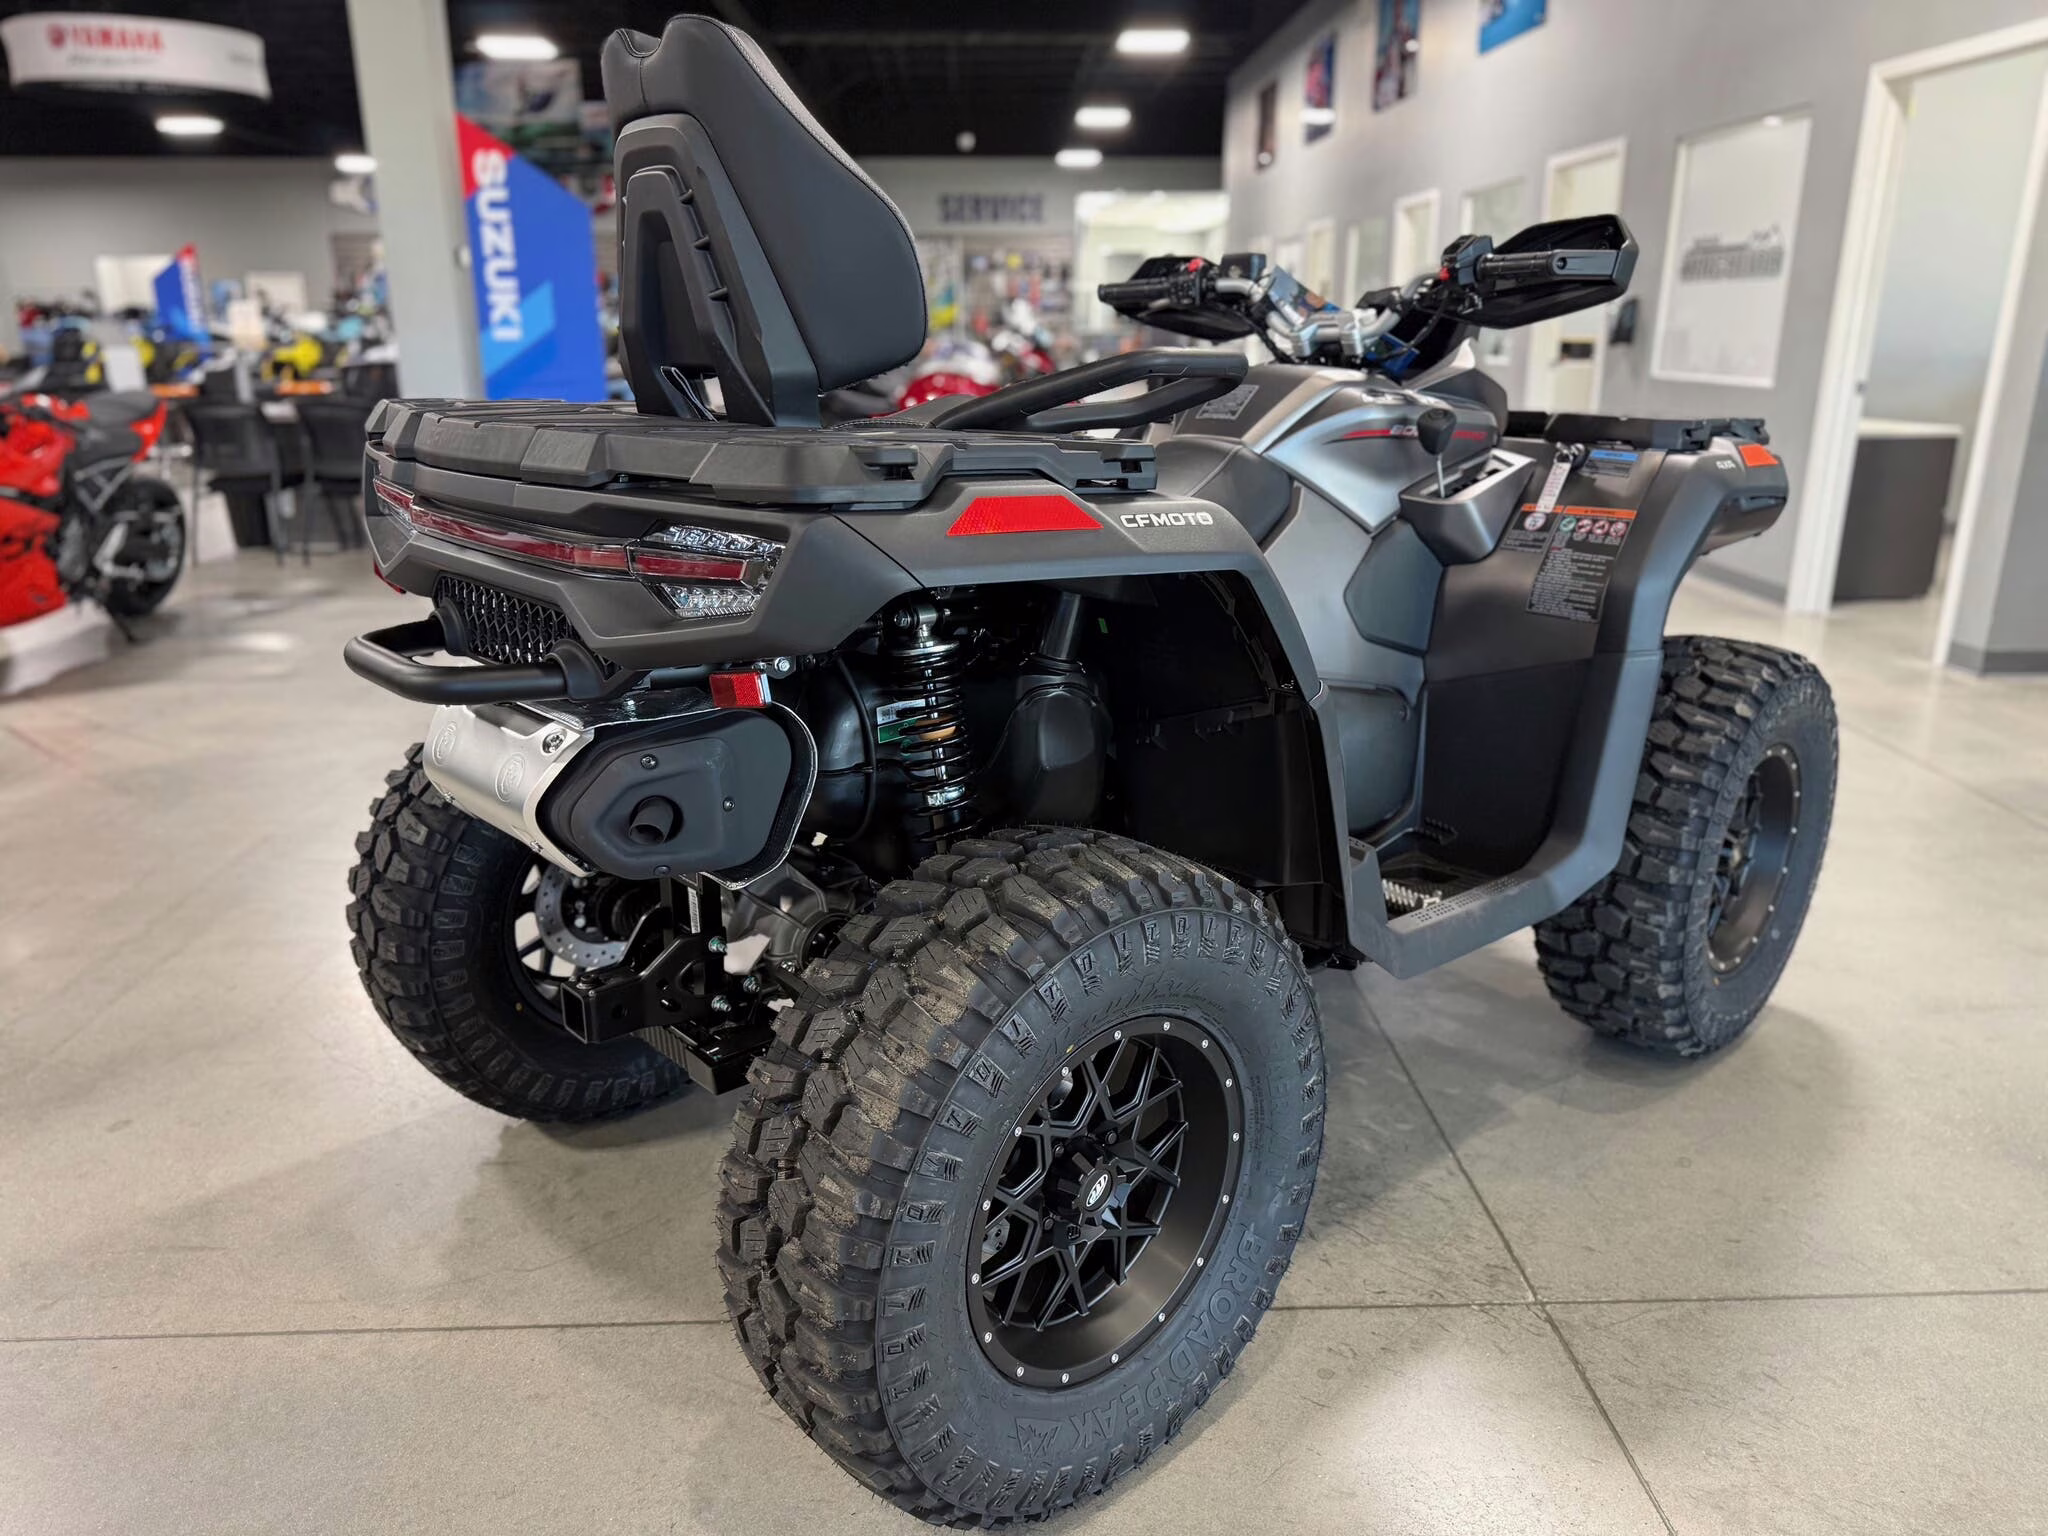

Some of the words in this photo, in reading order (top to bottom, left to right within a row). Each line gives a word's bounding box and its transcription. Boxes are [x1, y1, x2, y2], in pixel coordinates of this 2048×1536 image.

[472, 148, 525, 343] SUZUKI
[939, 193, 1043, 224] SERVICE
[1120, 512, 1213, 528] CFMOTO
[1068, 1223, 1265, 1449] BROADPEAK
